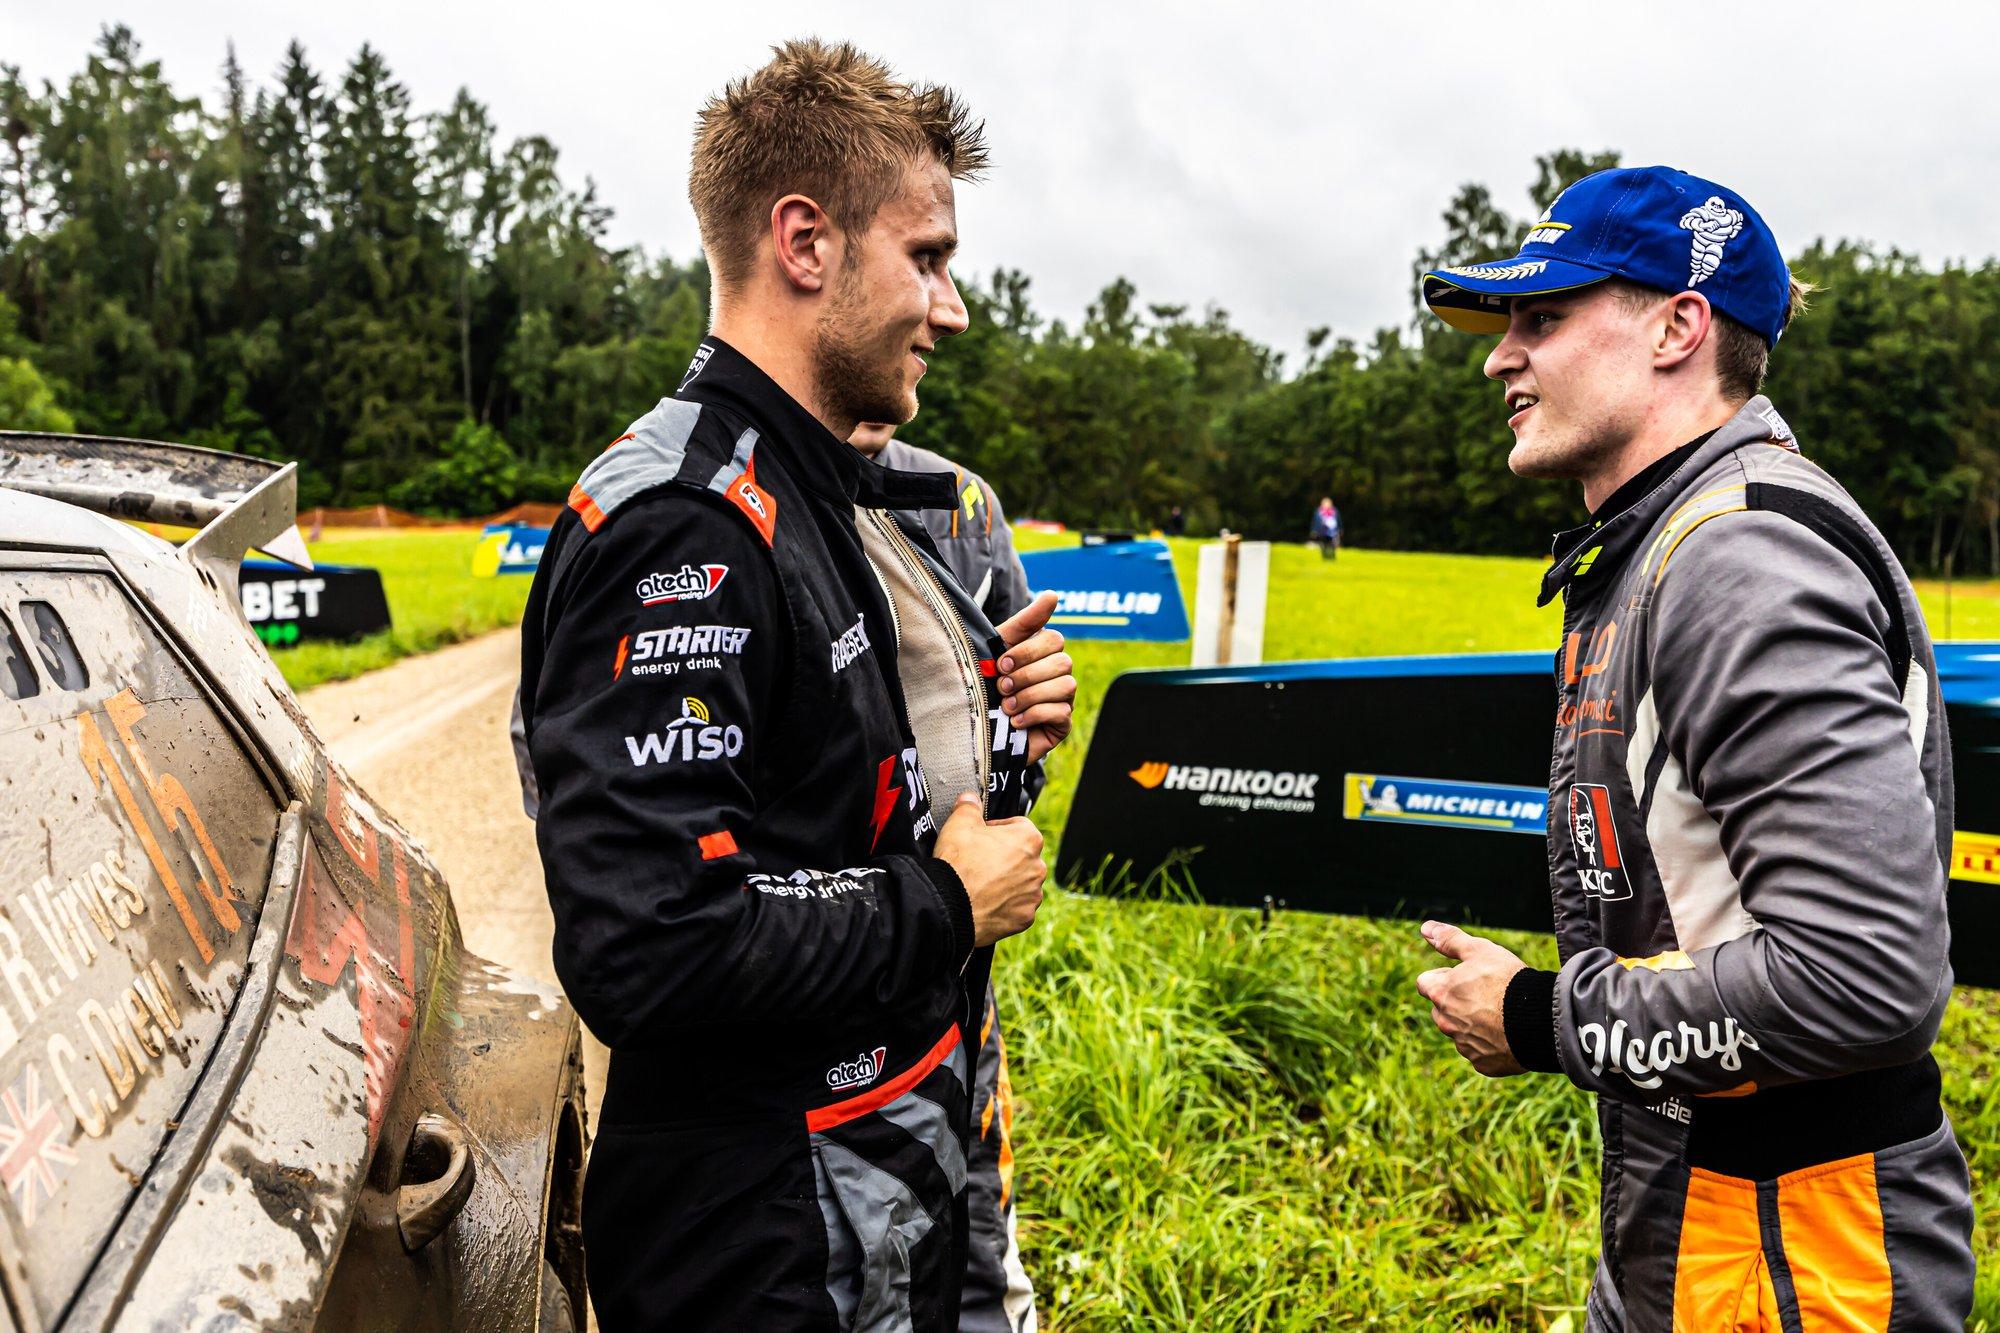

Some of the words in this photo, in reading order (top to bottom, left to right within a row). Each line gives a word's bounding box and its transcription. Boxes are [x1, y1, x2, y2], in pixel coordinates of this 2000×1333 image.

[636, 565, 705, 599] atech
[631, 625, 752, 661] STARTER
[631, 662, 680, 676] energy
[686, 656, 722, 672] drink
[1406, 793, 1545, 820] MICHELIN
